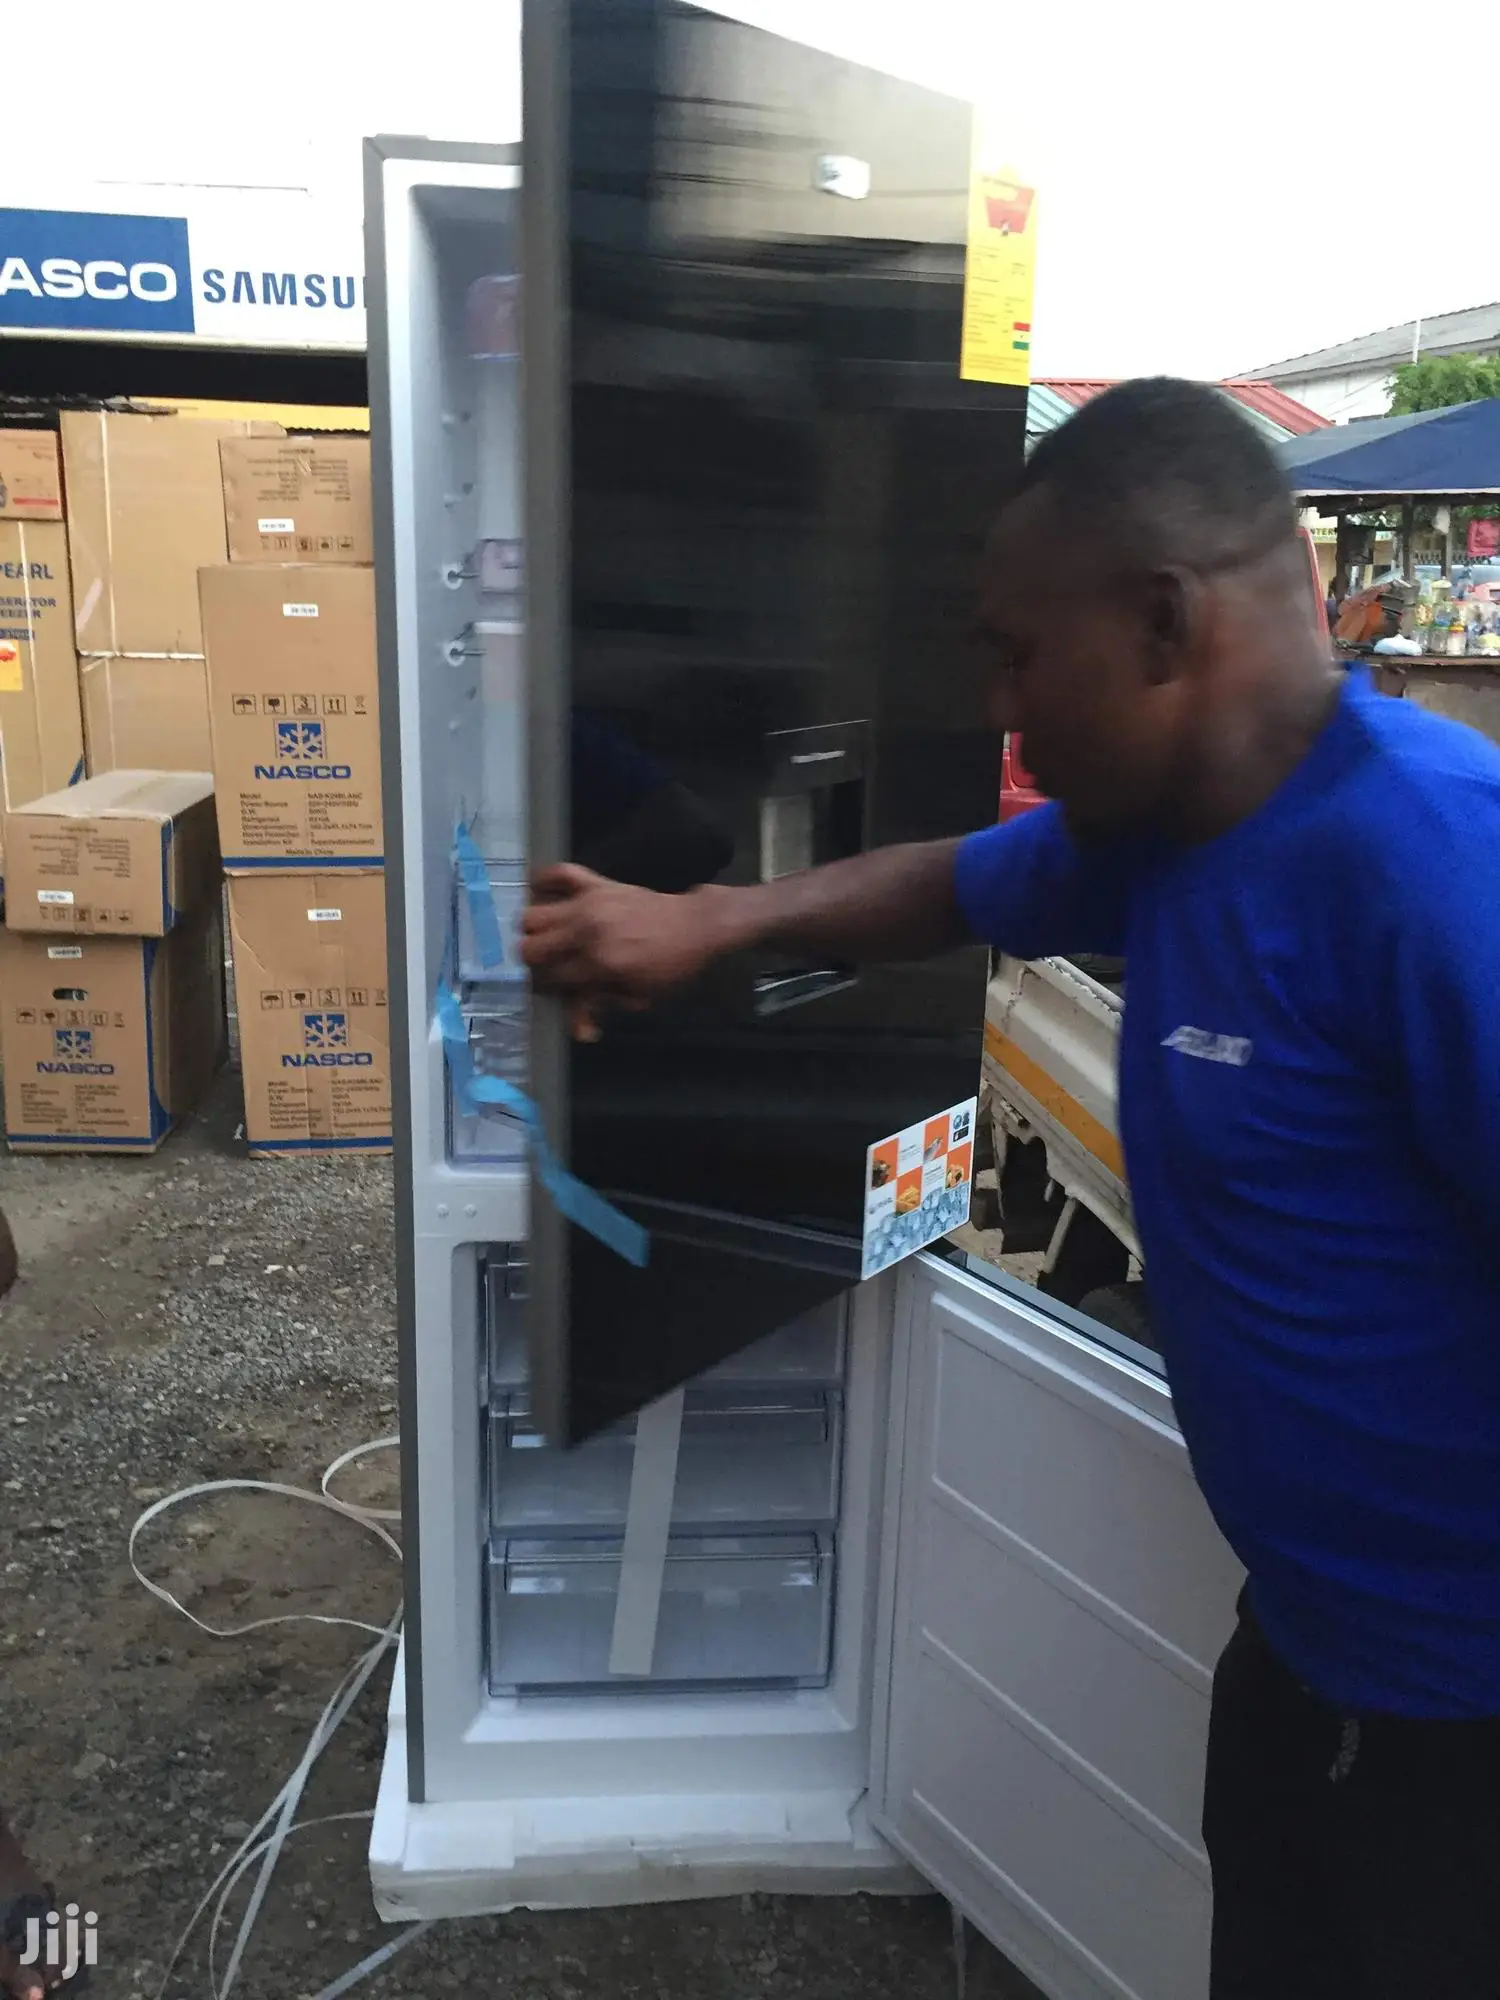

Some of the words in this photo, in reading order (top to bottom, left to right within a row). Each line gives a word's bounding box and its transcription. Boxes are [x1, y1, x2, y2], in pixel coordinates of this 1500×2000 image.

[203, 268, 367, 309] SAMSU
[254, 765, 351, 780] NASCO
[37, 1061, 115, 1075] NASCO
[281, 1053, 373, 1068] NASCO
